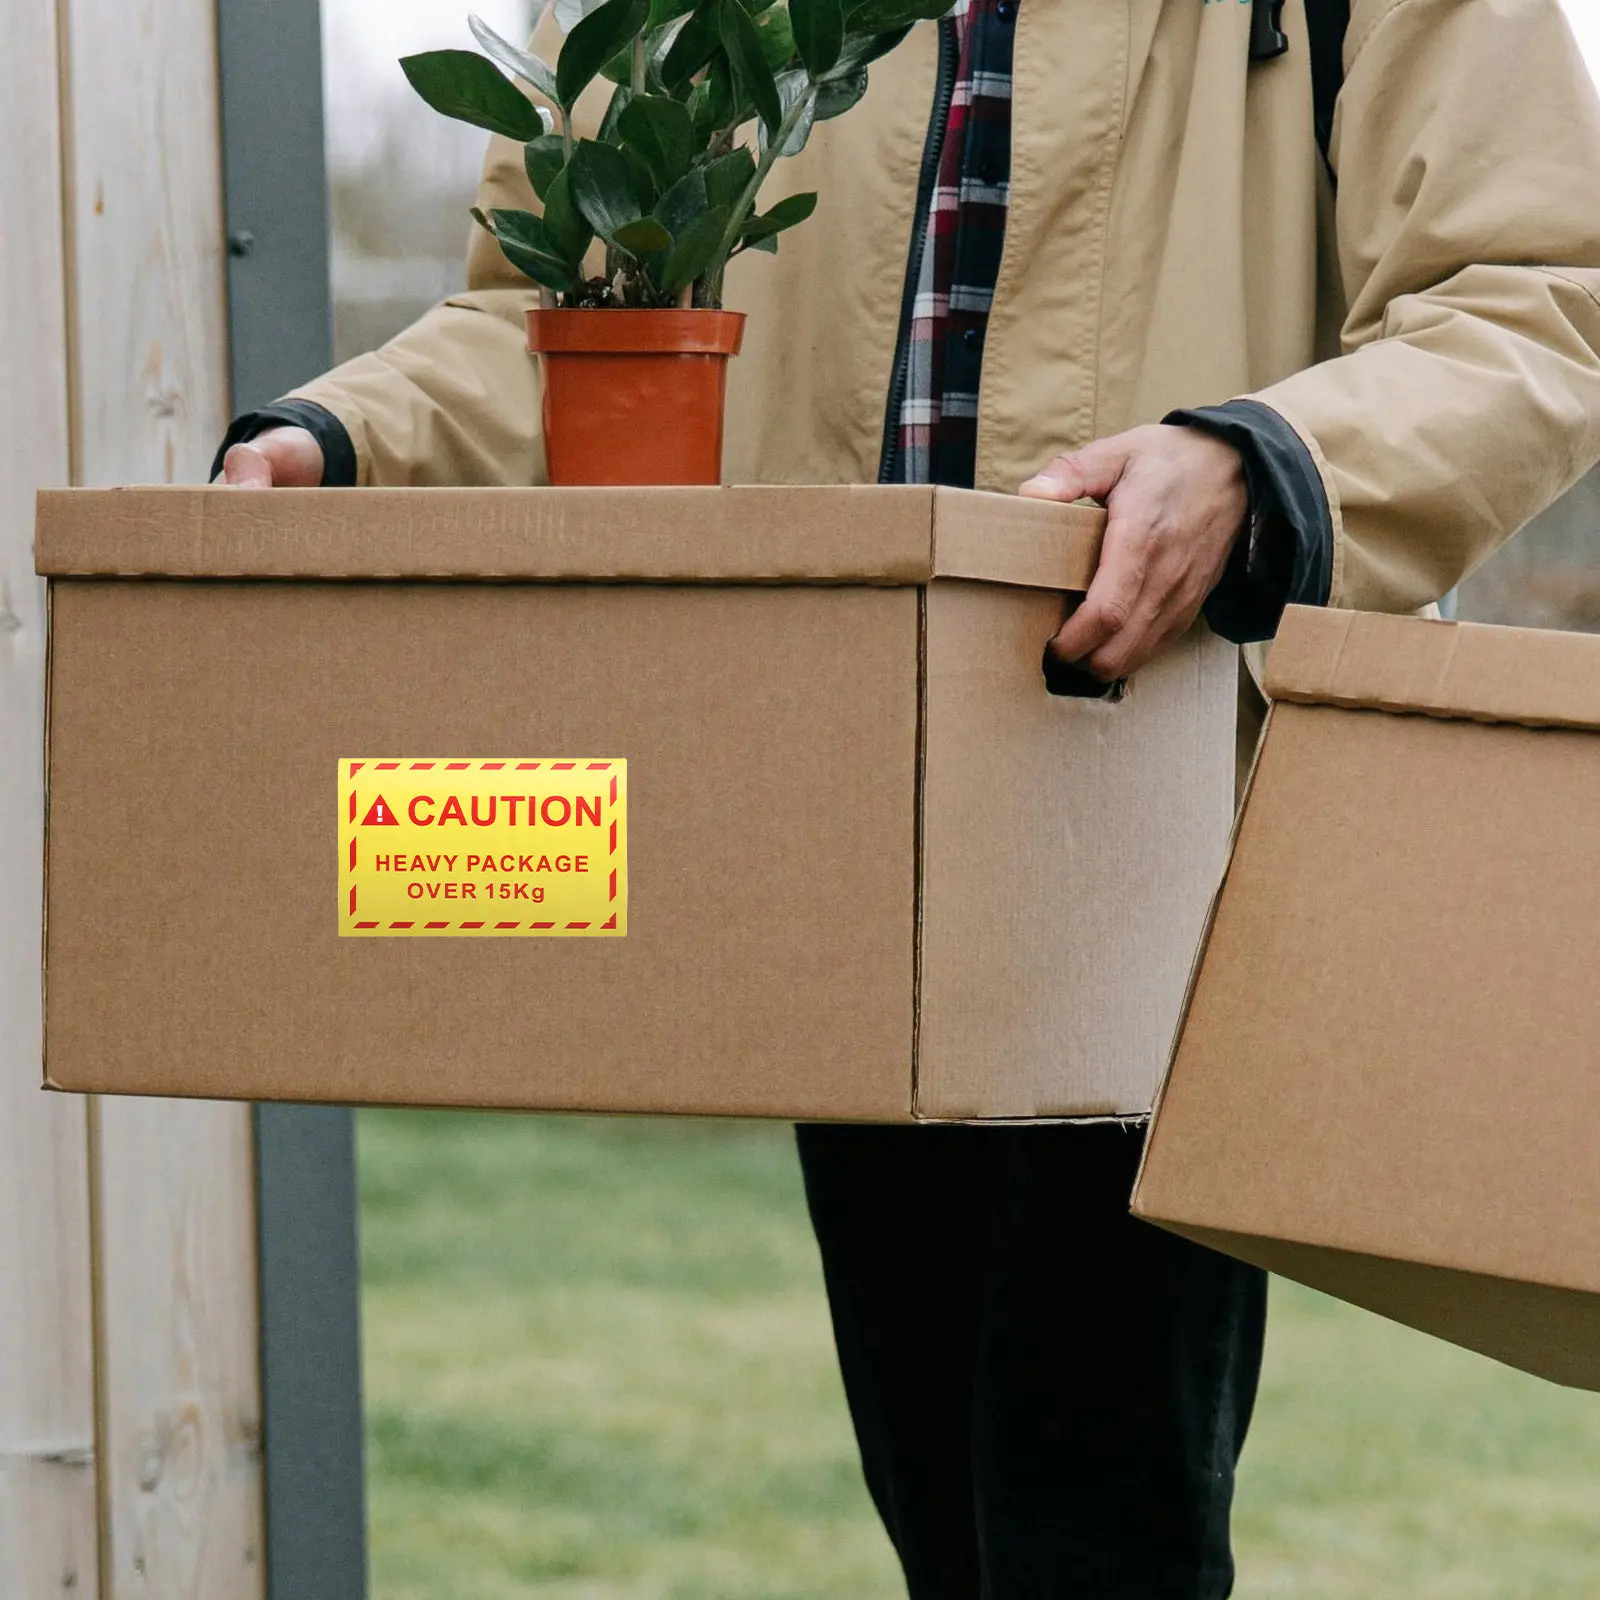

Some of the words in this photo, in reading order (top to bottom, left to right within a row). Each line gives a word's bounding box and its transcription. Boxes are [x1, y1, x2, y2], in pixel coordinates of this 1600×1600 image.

[408, 795, 602, 827] CAUTION
[375, 854, 458, 872] HEAVY
[467, 854, 589, 873] PACKAGE
[407, 882, 477, 899] OVER
[485, 883, 545, 904] 15Kg
